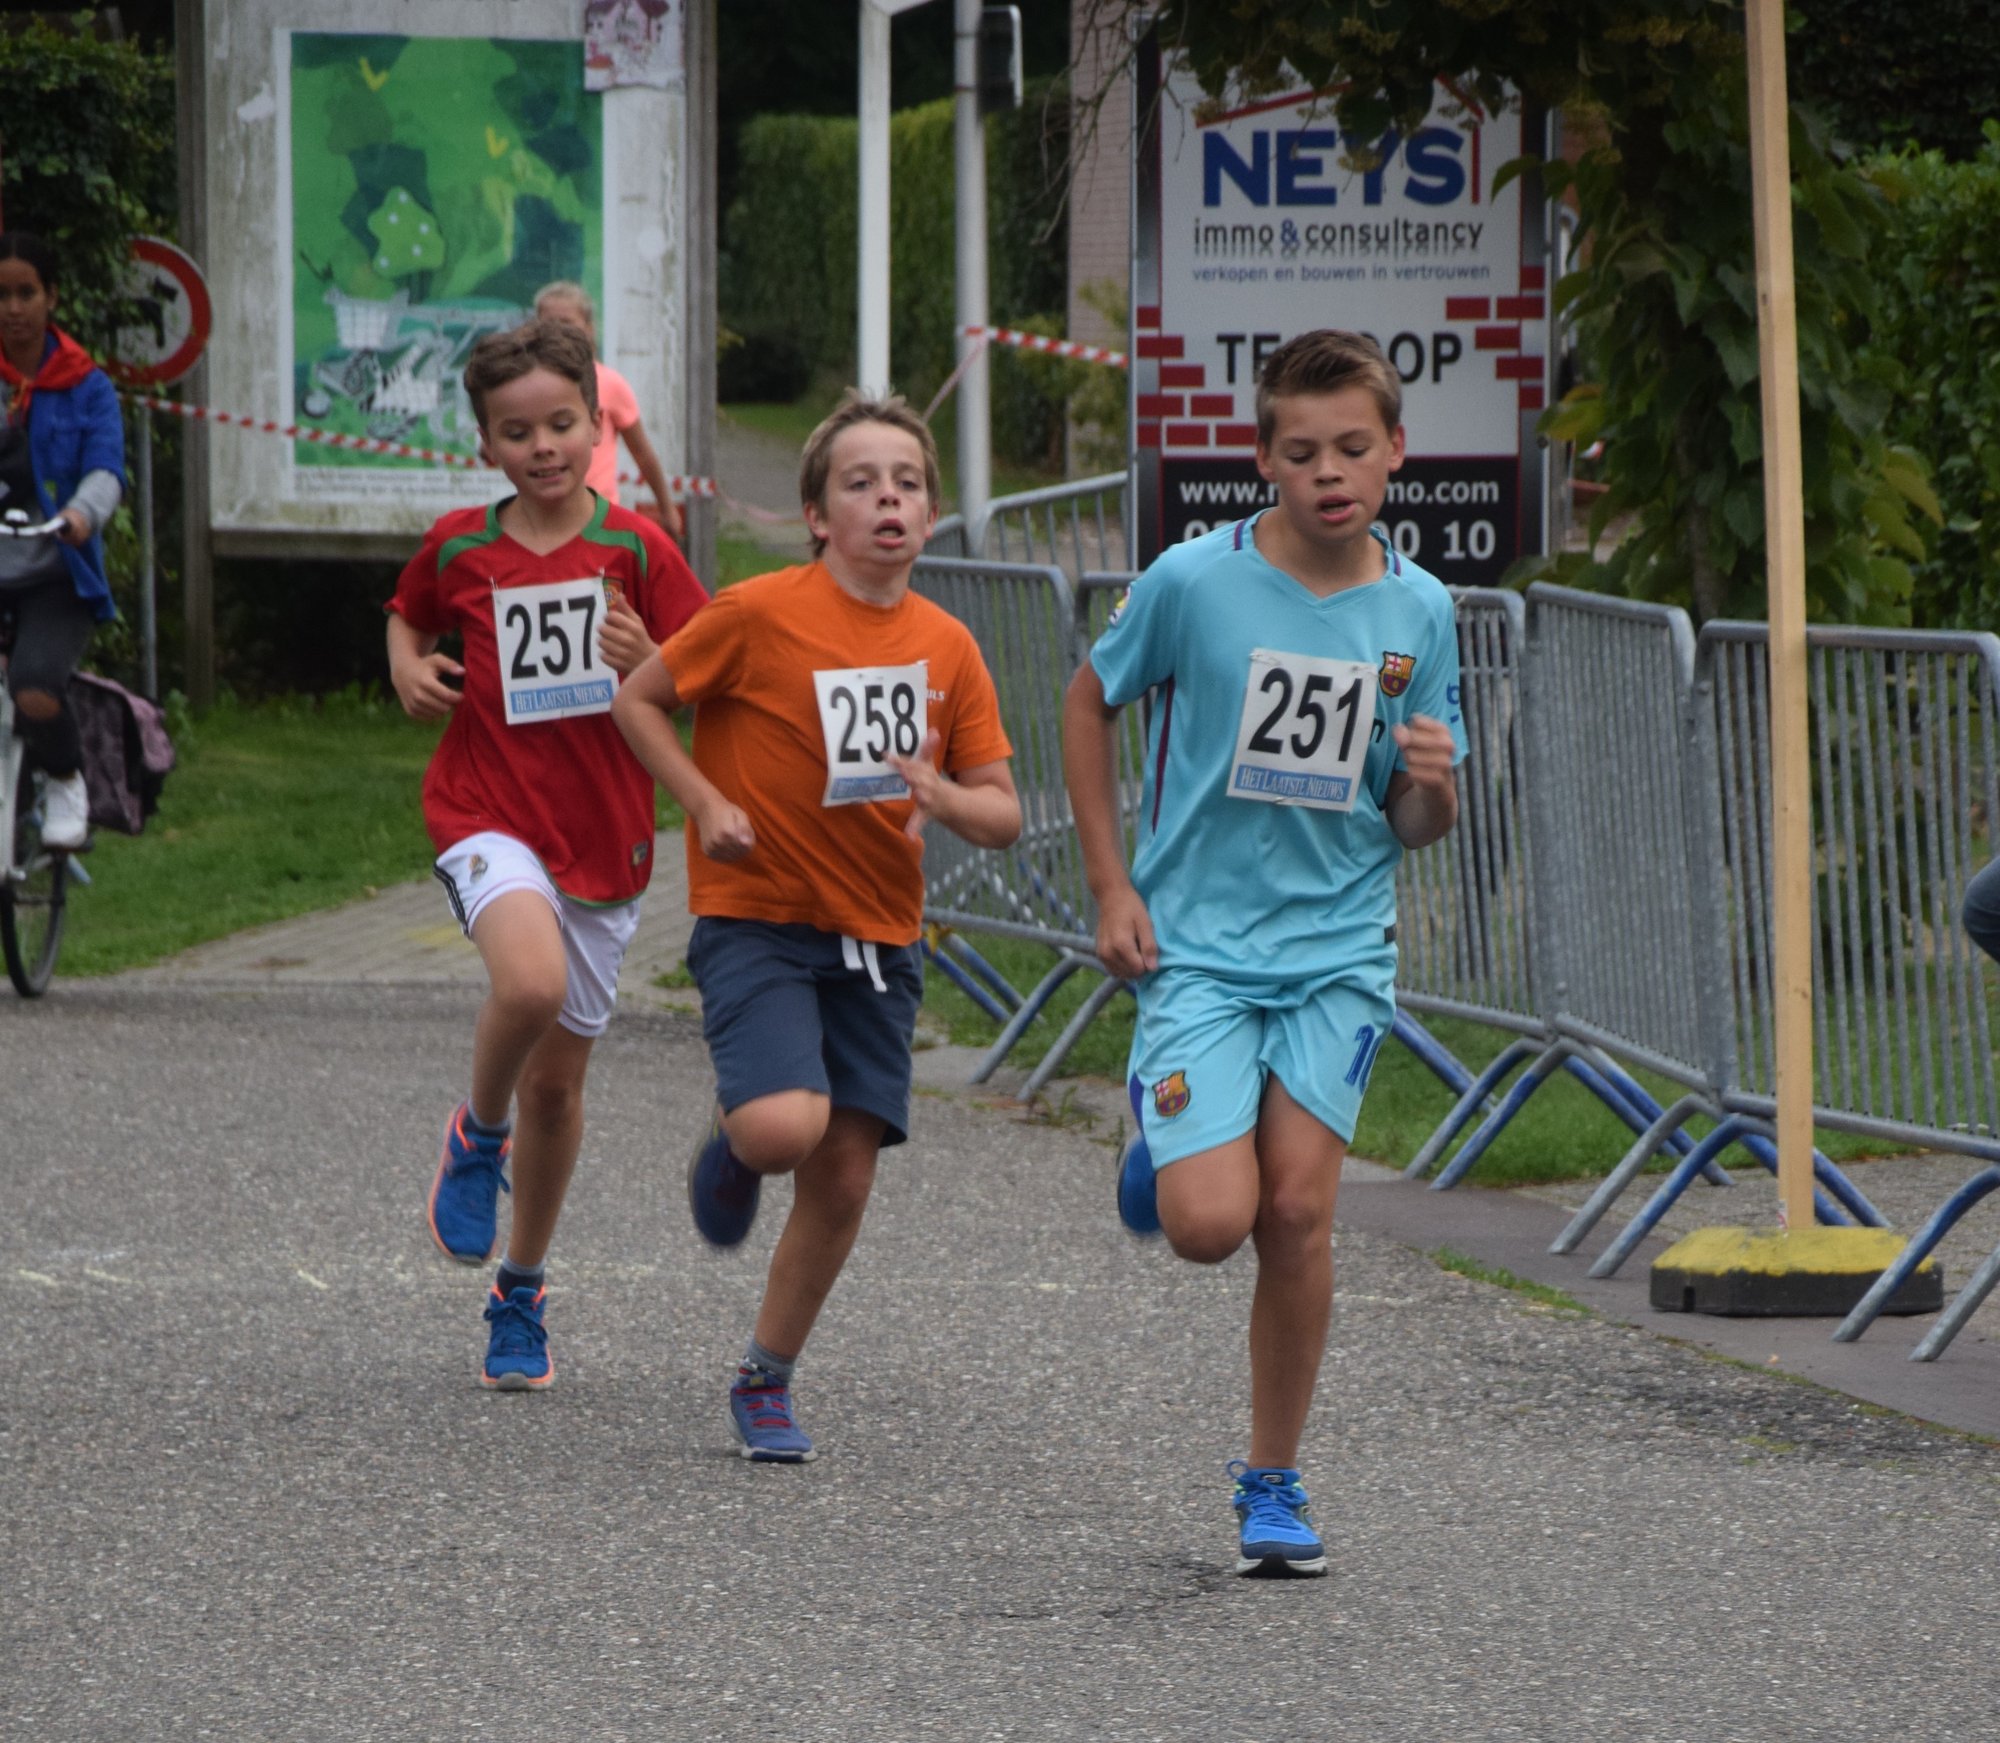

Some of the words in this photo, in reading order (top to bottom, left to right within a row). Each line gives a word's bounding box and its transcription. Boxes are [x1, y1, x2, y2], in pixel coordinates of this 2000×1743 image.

[1203, 127, 1465, 207] NEYS
[1192, 264, 1269, 283] verkopen
[1274, 268, 1295, 280] en
[1301, 264, 1367, 280] bouwen
[1372, 264, 1388, 280] in
[1395, 265, 1491, 280] vertrouwen
[1195, 219, 1274, 244] immo
[1280, 220, 1299, 244] &
[1305, 219, 1484, 249] consultancy
[1442, 519, 1496, 561] 10
[505, 595, 597, 680] 257
[830, 682, 919, 763] 258
[1248, 667, 1363, 762] 251
